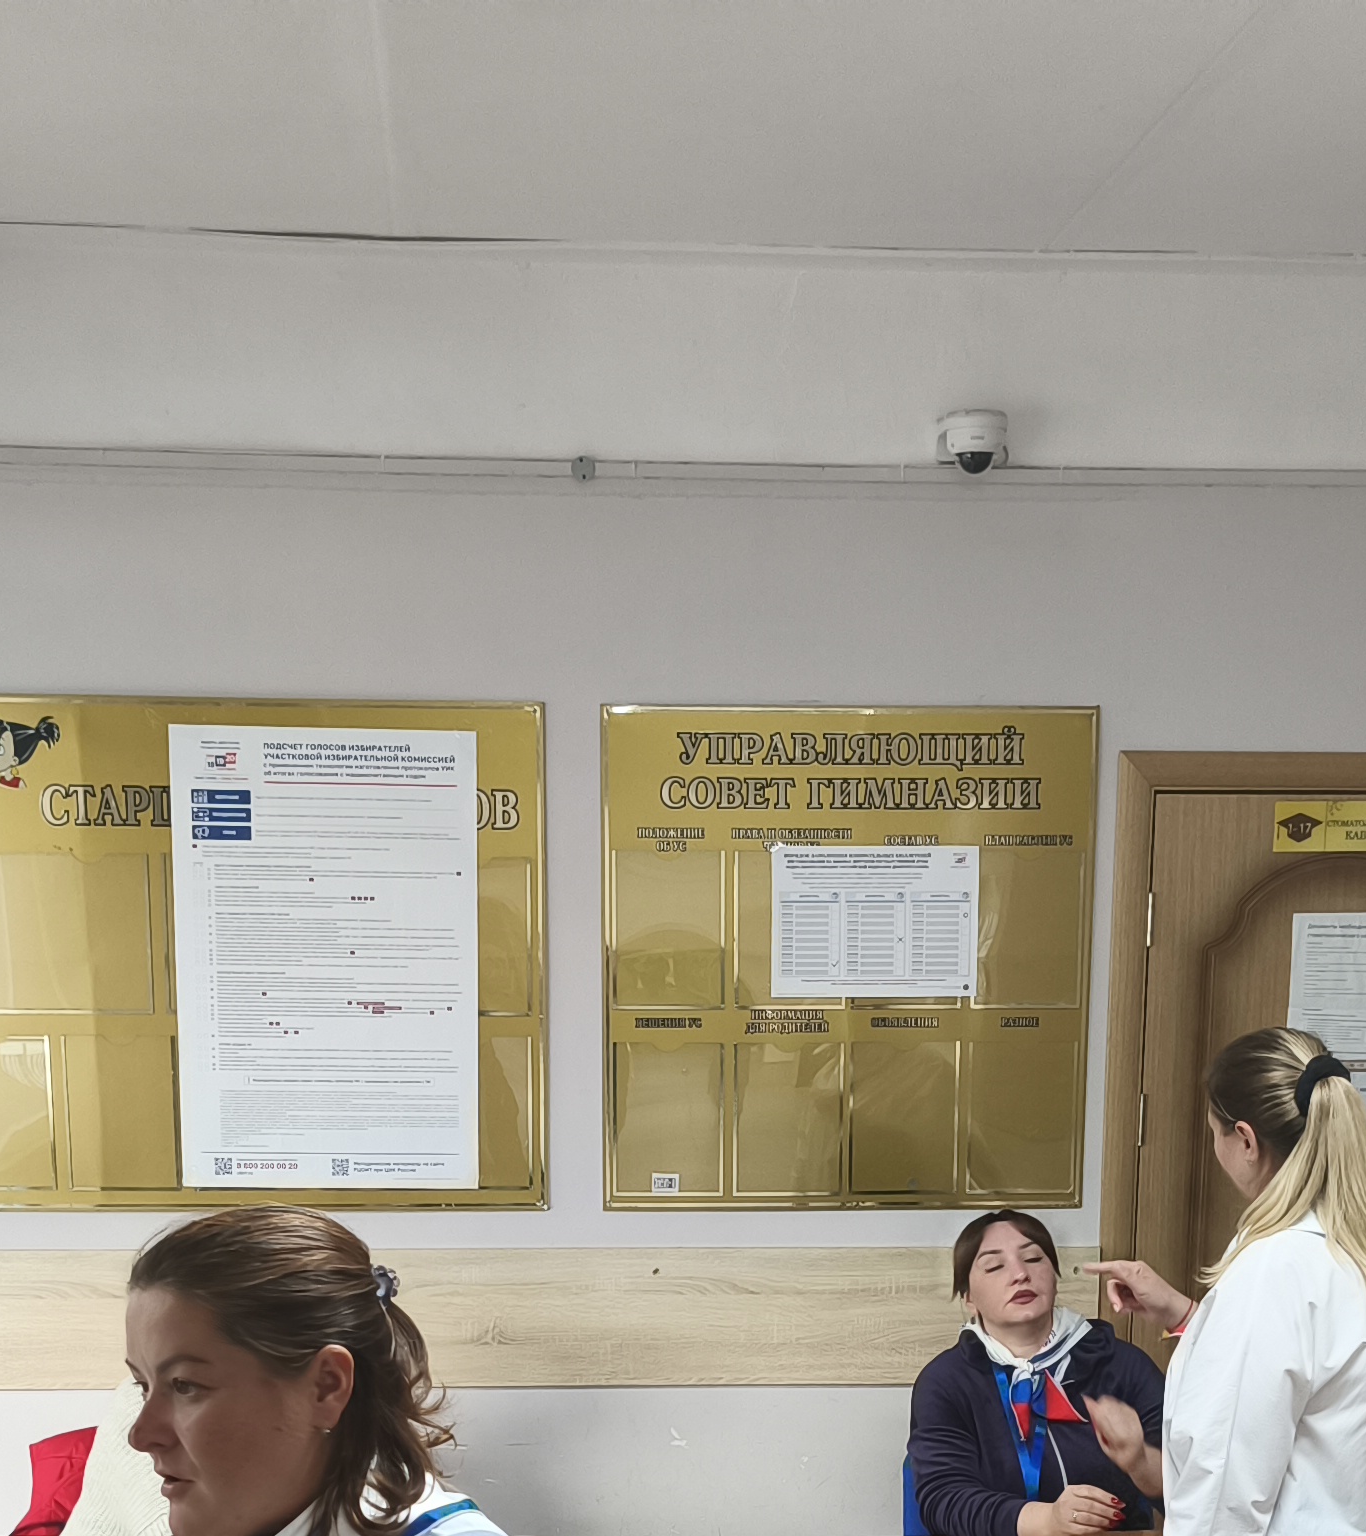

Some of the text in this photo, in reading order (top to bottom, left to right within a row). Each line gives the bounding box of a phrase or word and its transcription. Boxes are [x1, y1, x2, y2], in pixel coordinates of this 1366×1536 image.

[263, 743, 411, 753] ПОДСЧЕТ ГОЛОСОВ ИЗБИРАТЕЛЕЙ
[677, 726, 1024, 771] УПРАВЛЯЮЩИЙ
[263, 753, 456, 764] УЧАСТКОВОЙ ИЗБИРАТЕЛЬНОЙ КОМИССИЕЙ
[660, 776, 1041, 810] СОВЕТ ГИМНАЗИИ
[637, 827, 706, 839] ПОЛОЖЕНИЕ
[731, 828, 766, 840] ПРАВА
[778, 828, 852, 840] ОБЯЗАННОСТИ
[1288, 822, 1312, 834] 1-17
[656, 841, 687, 852] ОБ УС
[751, 1009, 823, 1022] ИНФОРМАЦИЯ
[768, 1020, 829, 1035] РОДИТЕЛЕЙ
